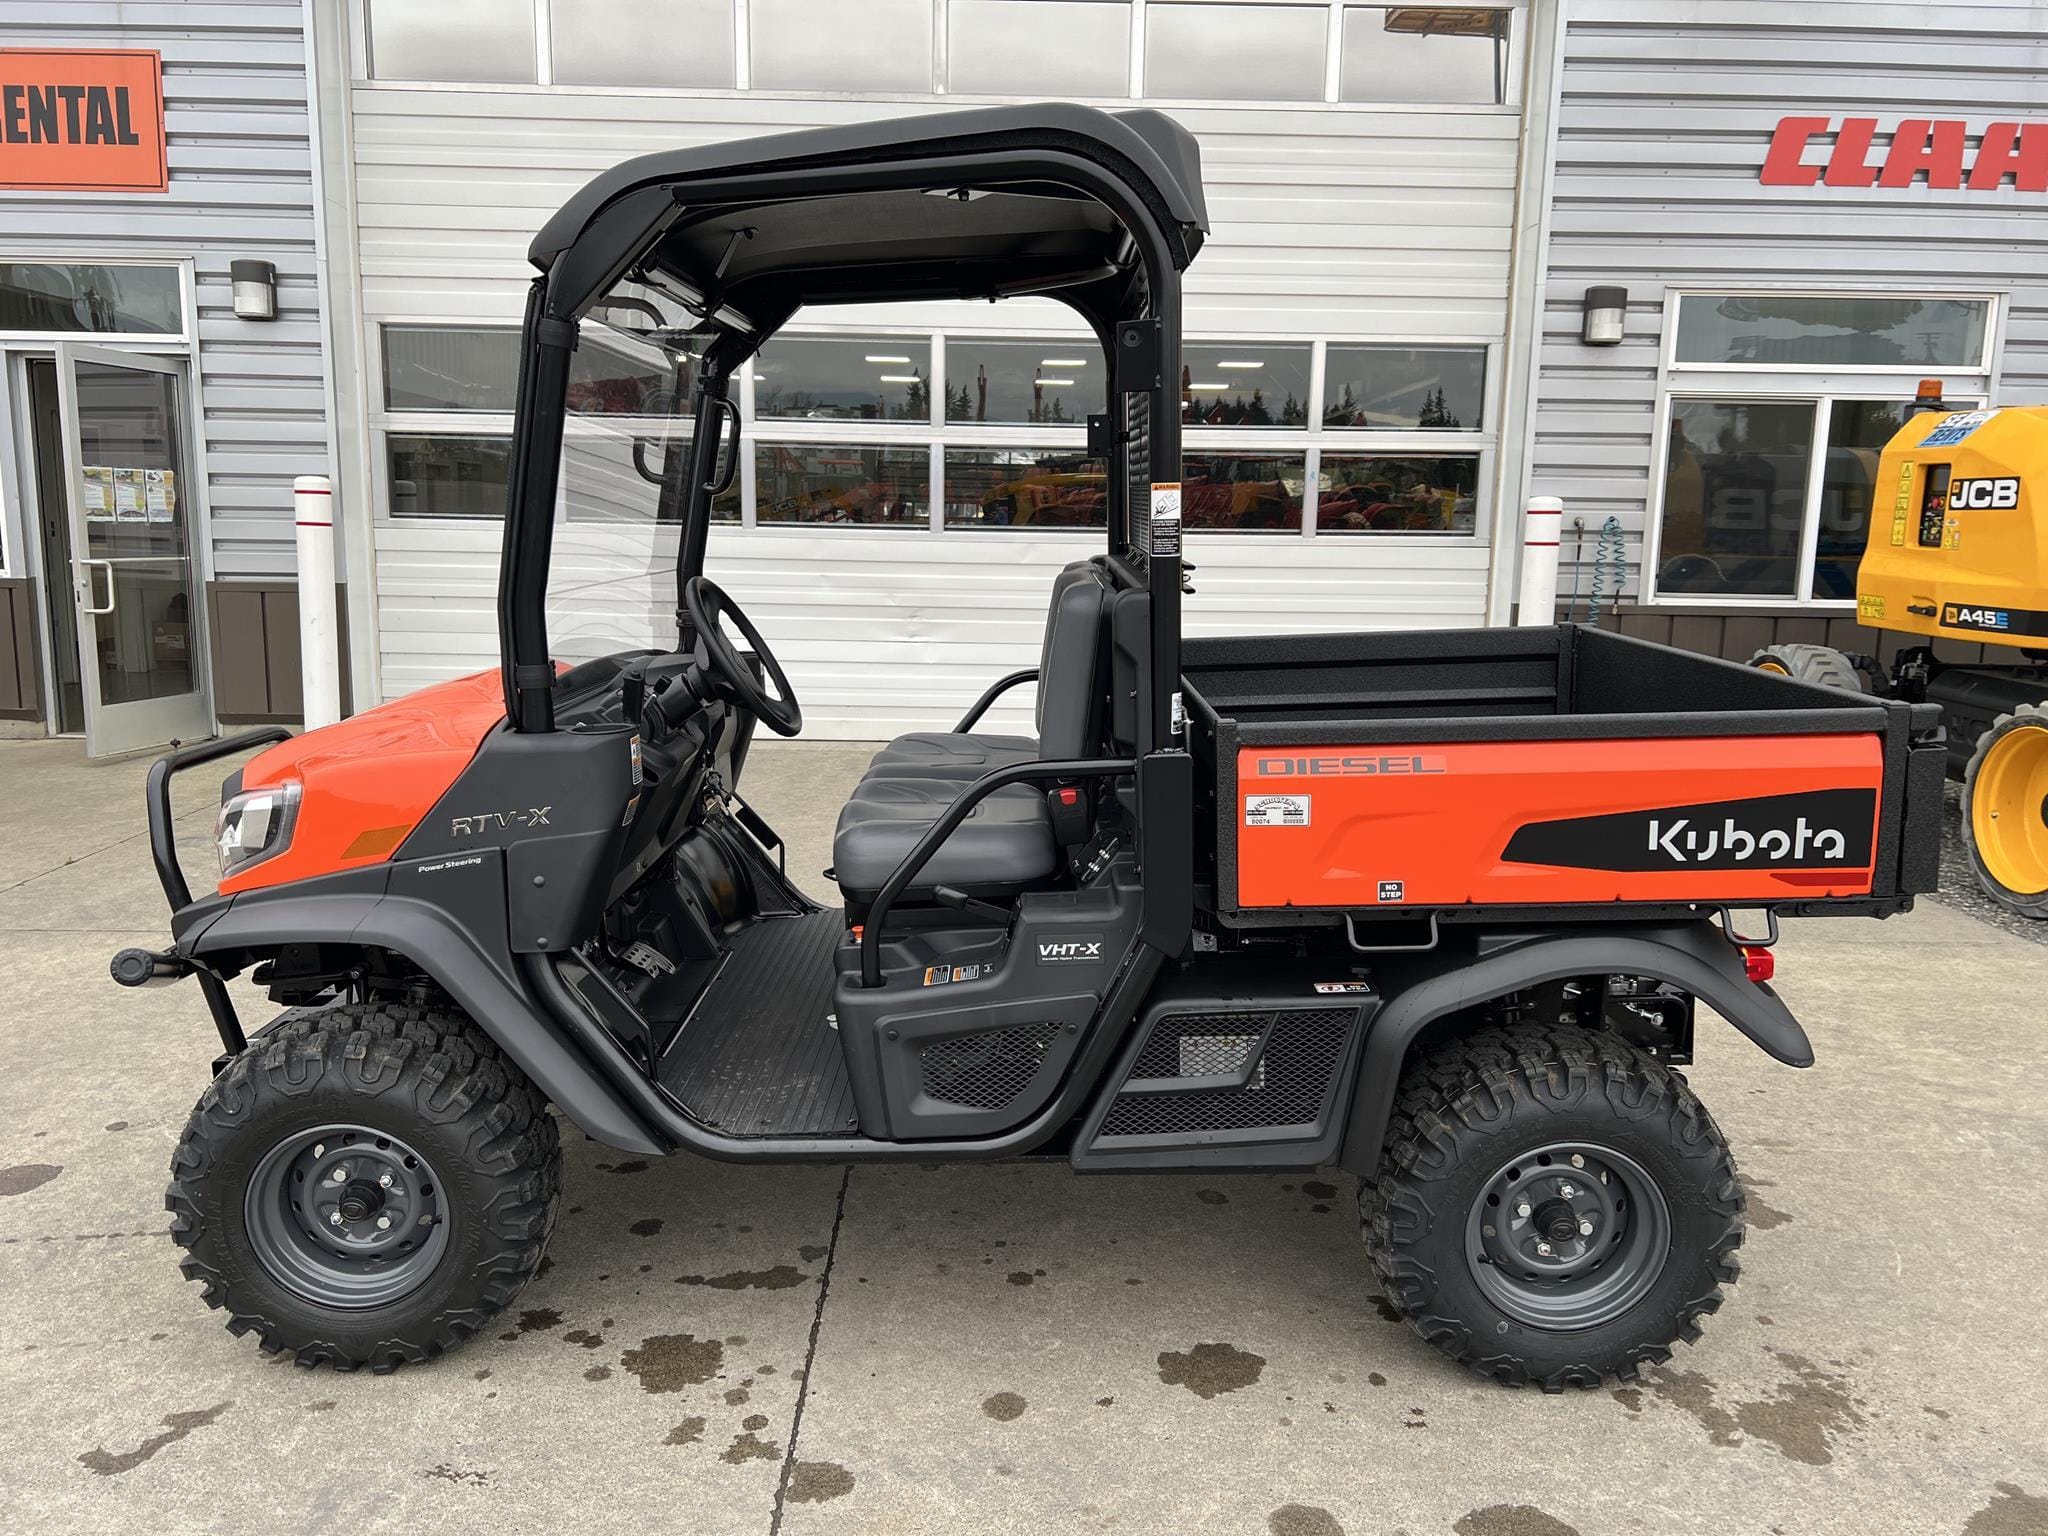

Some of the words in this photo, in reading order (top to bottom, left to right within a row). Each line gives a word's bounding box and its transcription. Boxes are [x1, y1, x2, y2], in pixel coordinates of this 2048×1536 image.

[0, 84, 141, 147] ENTAL
[1950, 479, 2018, 509] JCB
[1959, 608, 2009, 627] A45E
[1258, 756, 1445, 776] DIESEL
[450, 806, 552, 837] RTV-X
[1647, 816, 1846, 862] Kubota
[418, 863, 445, 873] Power
[445, 857, 482, 870] Steering
[1385, 883, 1398, 891] NO
[1038, 942, 1102, 956] VHT-X
